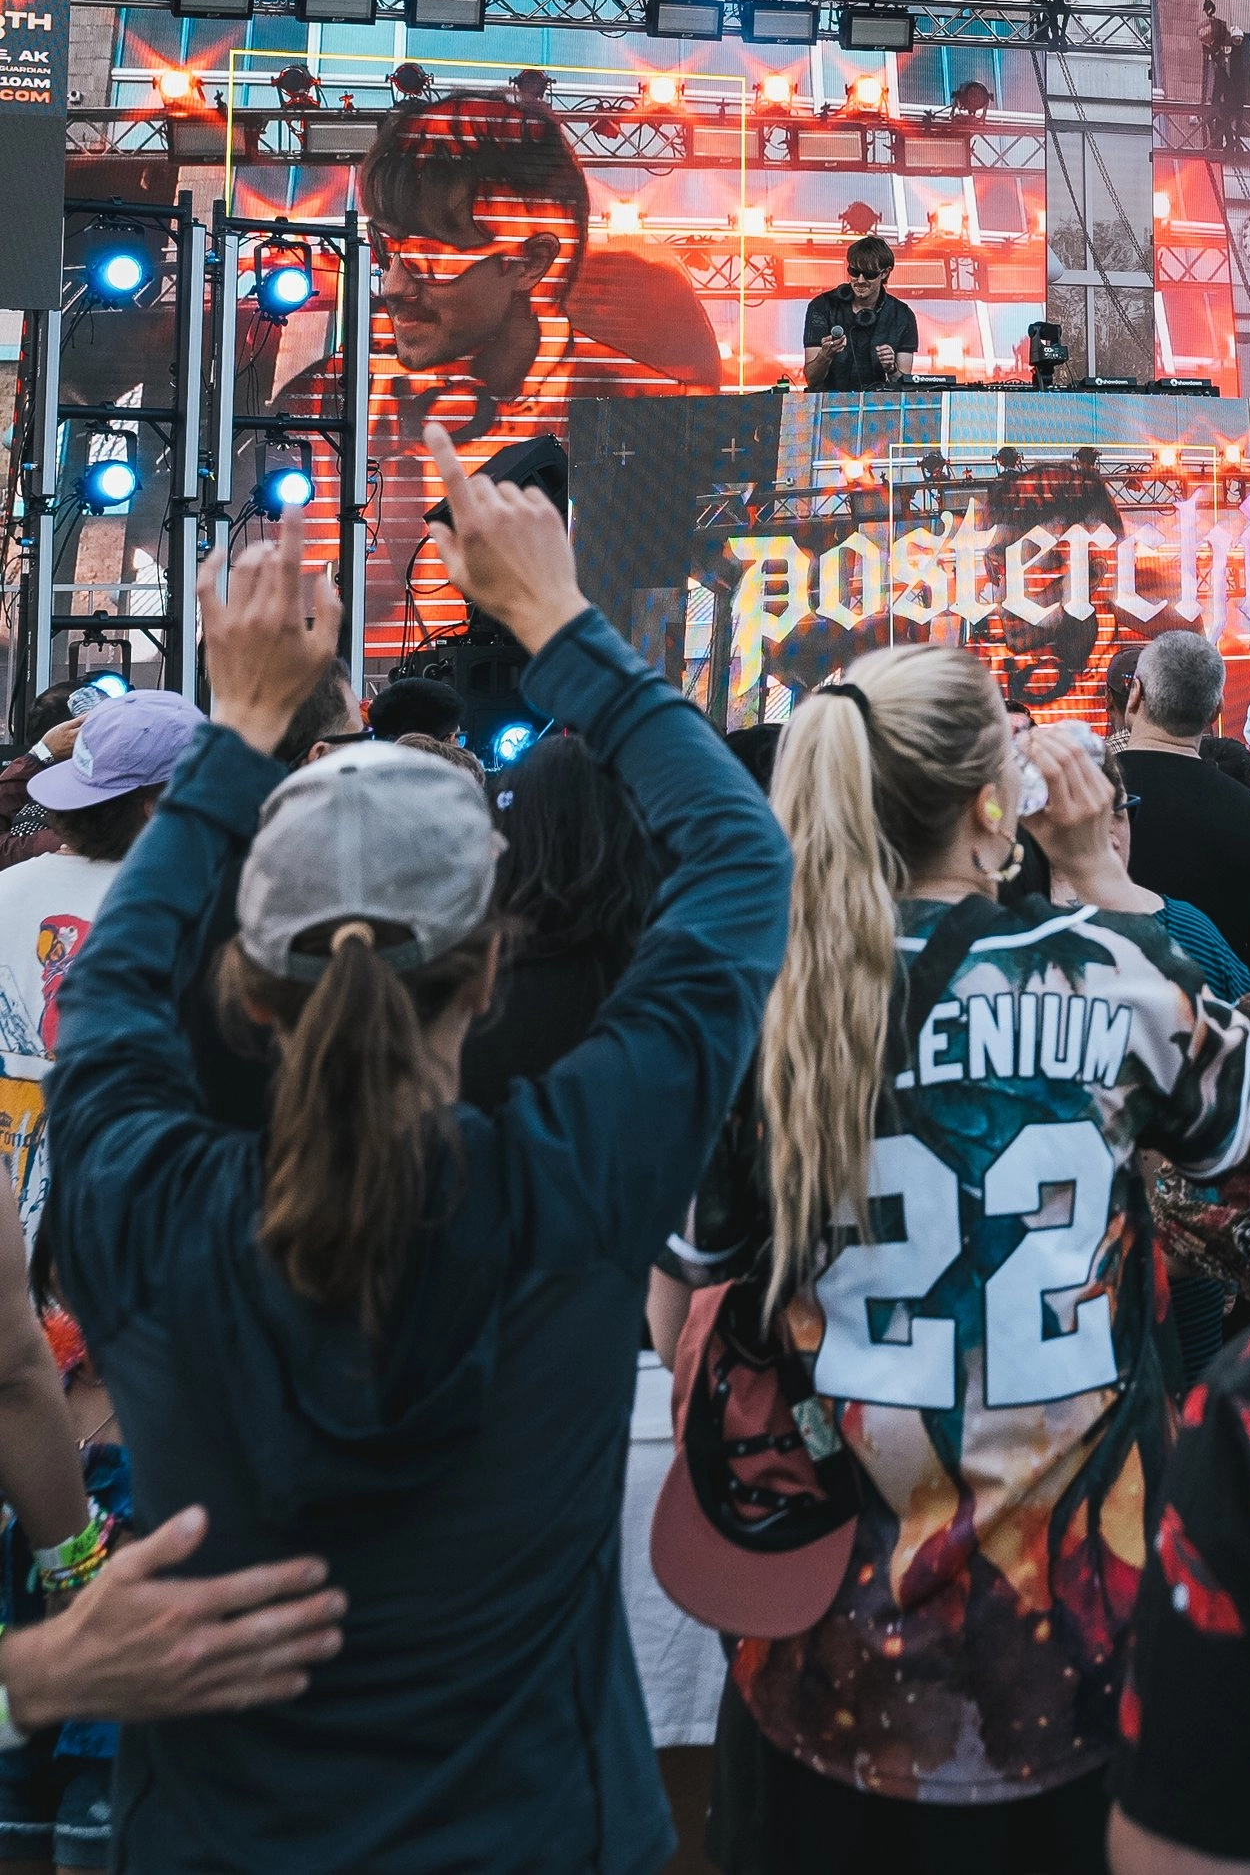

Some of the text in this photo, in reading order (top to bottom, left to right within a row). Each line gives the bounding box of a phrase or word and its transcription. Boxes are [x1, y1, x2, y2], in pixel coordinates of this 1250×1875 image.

[0, 10, 51, 39] TH
[19, 50, 49, 63] AK
[0, 65, 51, 74] GUARDIAN
[0, 76, 51, 89] 10AM
[895, 992, 1133, 1090] ENIUM
[814, 1120, 1120, 1410] 22
